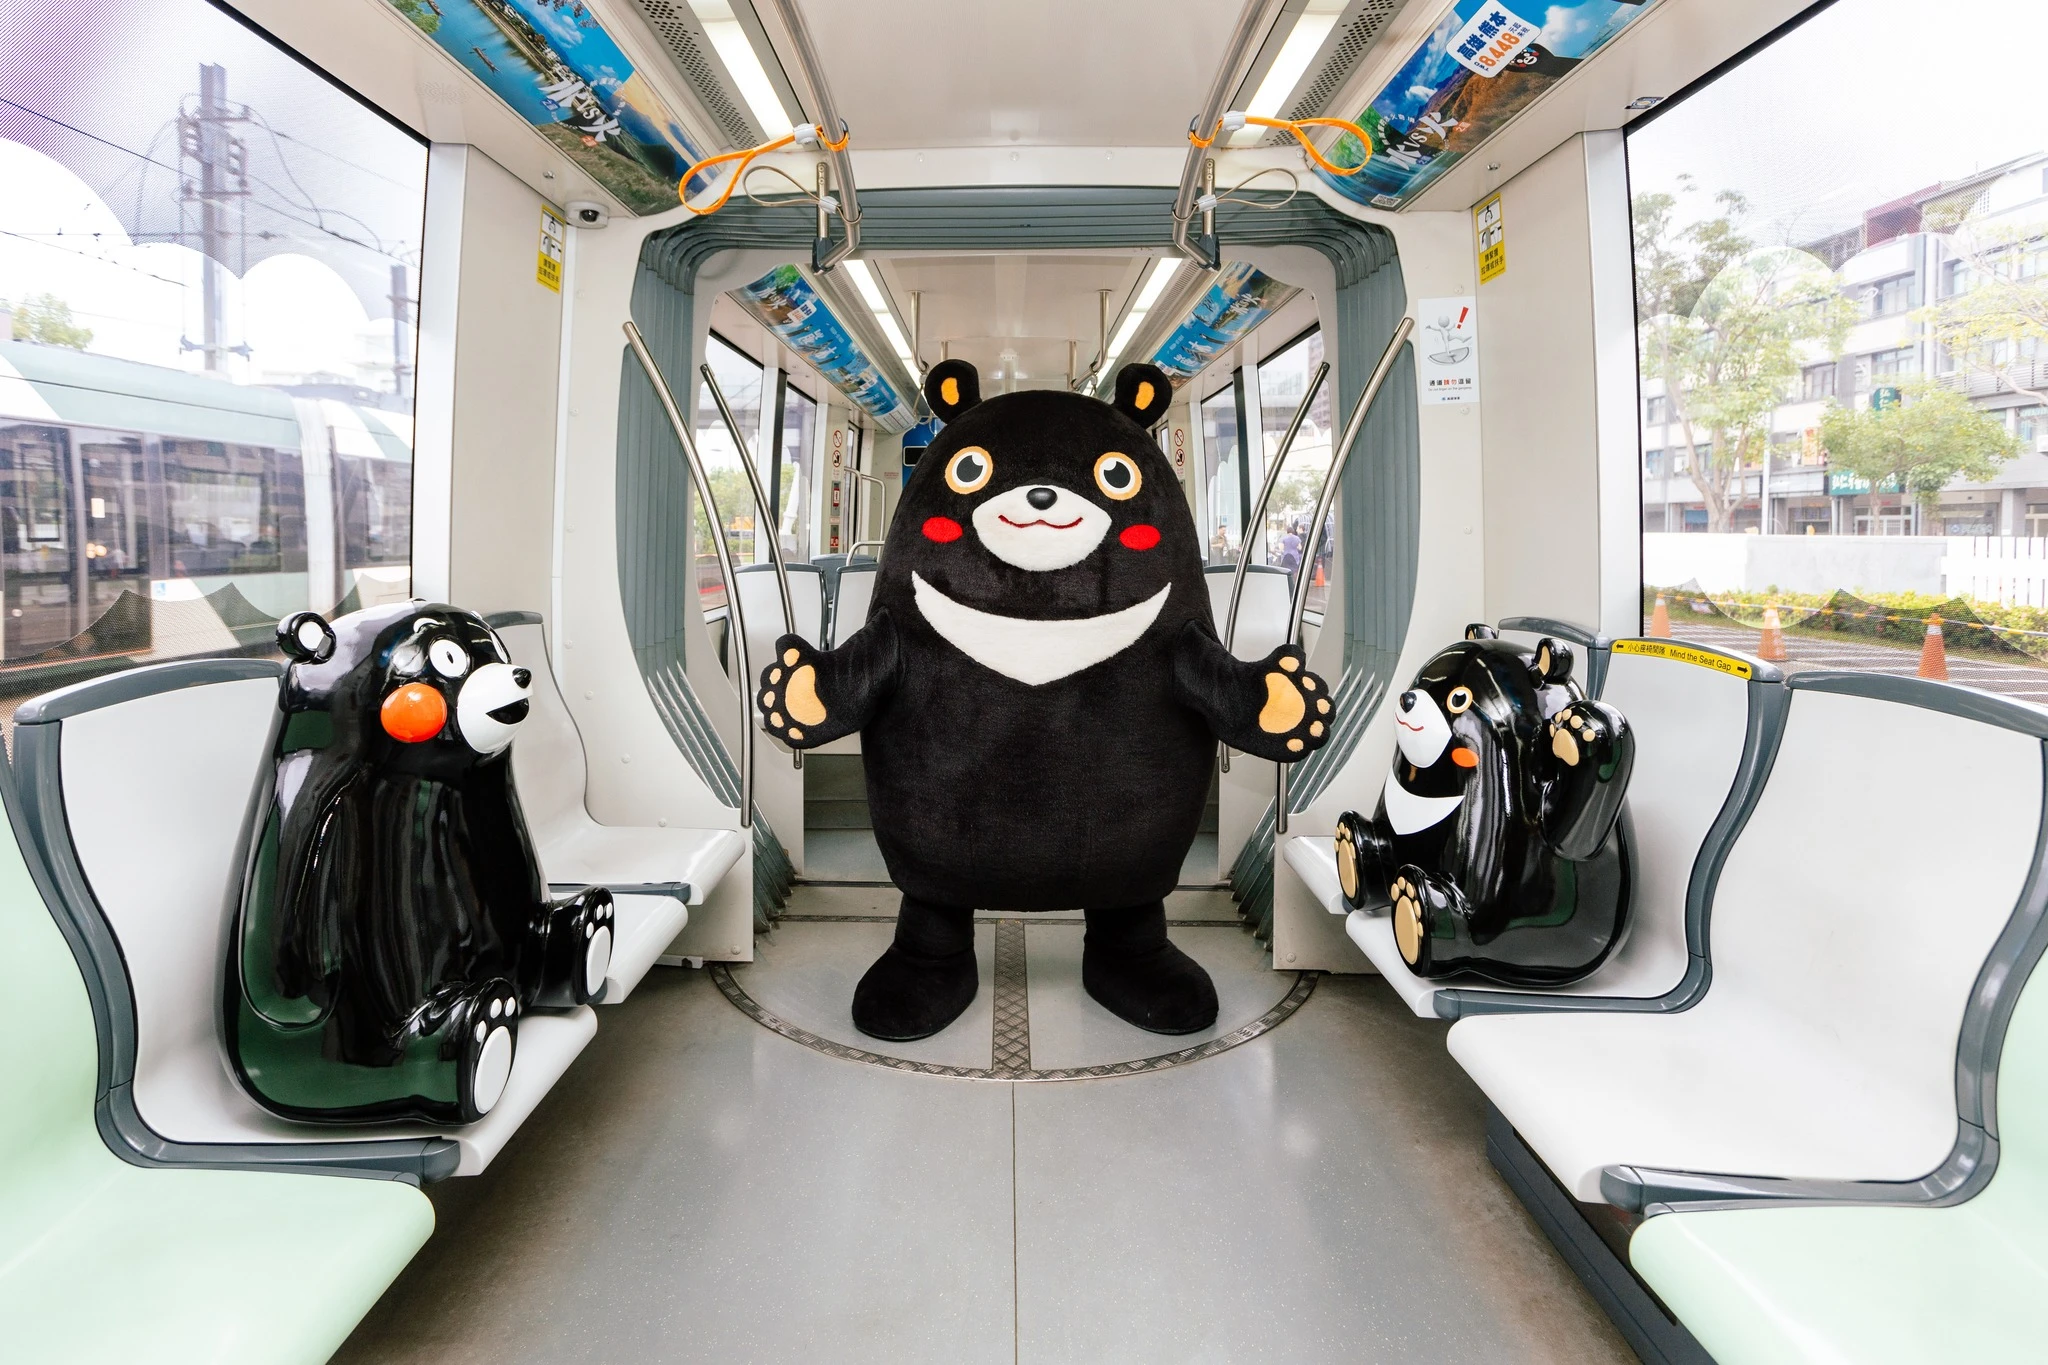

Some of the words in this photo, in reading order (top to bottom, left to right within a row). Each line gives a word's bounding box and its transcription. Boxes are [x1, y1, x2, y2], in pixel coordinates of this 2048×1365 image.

[1669, 648, 1686, 660] Mind
[1687, 652, 1698, 663] the
[1699, 654, 1715, 667] Seat
[1716, 659, 1732, 672] Gap
